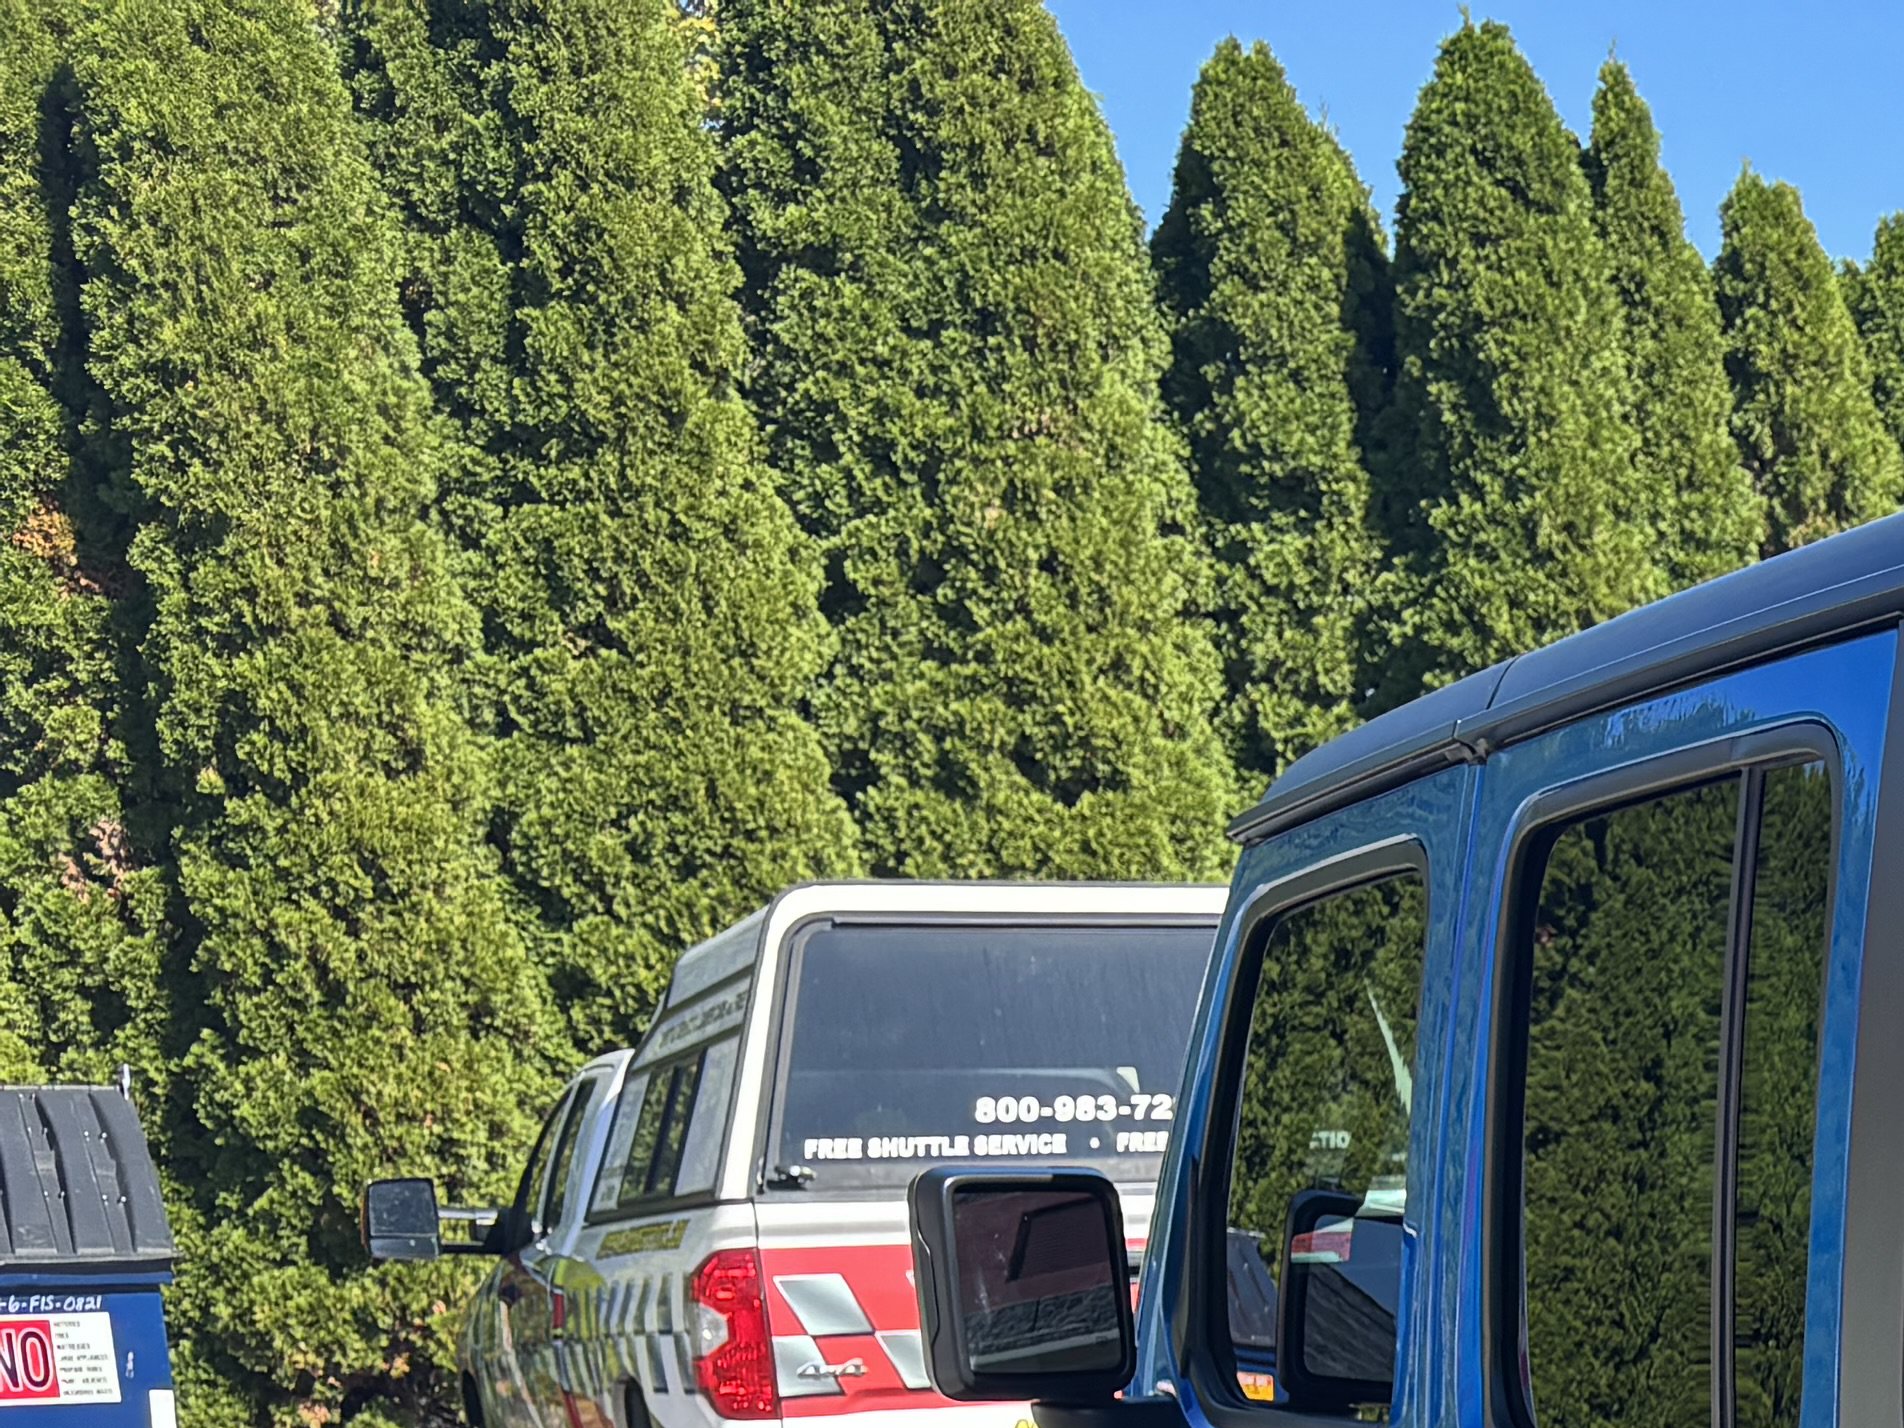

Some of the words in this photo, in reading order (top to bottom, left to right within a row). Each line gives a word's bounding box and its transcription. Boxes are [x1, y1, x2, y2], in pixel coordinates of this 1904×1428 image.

[975, 1094, 1176, 1123] 800-983-72
[804, 1137, 863, 1159] FREE
[867, 1134, 970, 1158] SHUTTLE
[973, 1132, 1068, 1156] SERVICE
[797, 1357, 869, 1378] 4x4
